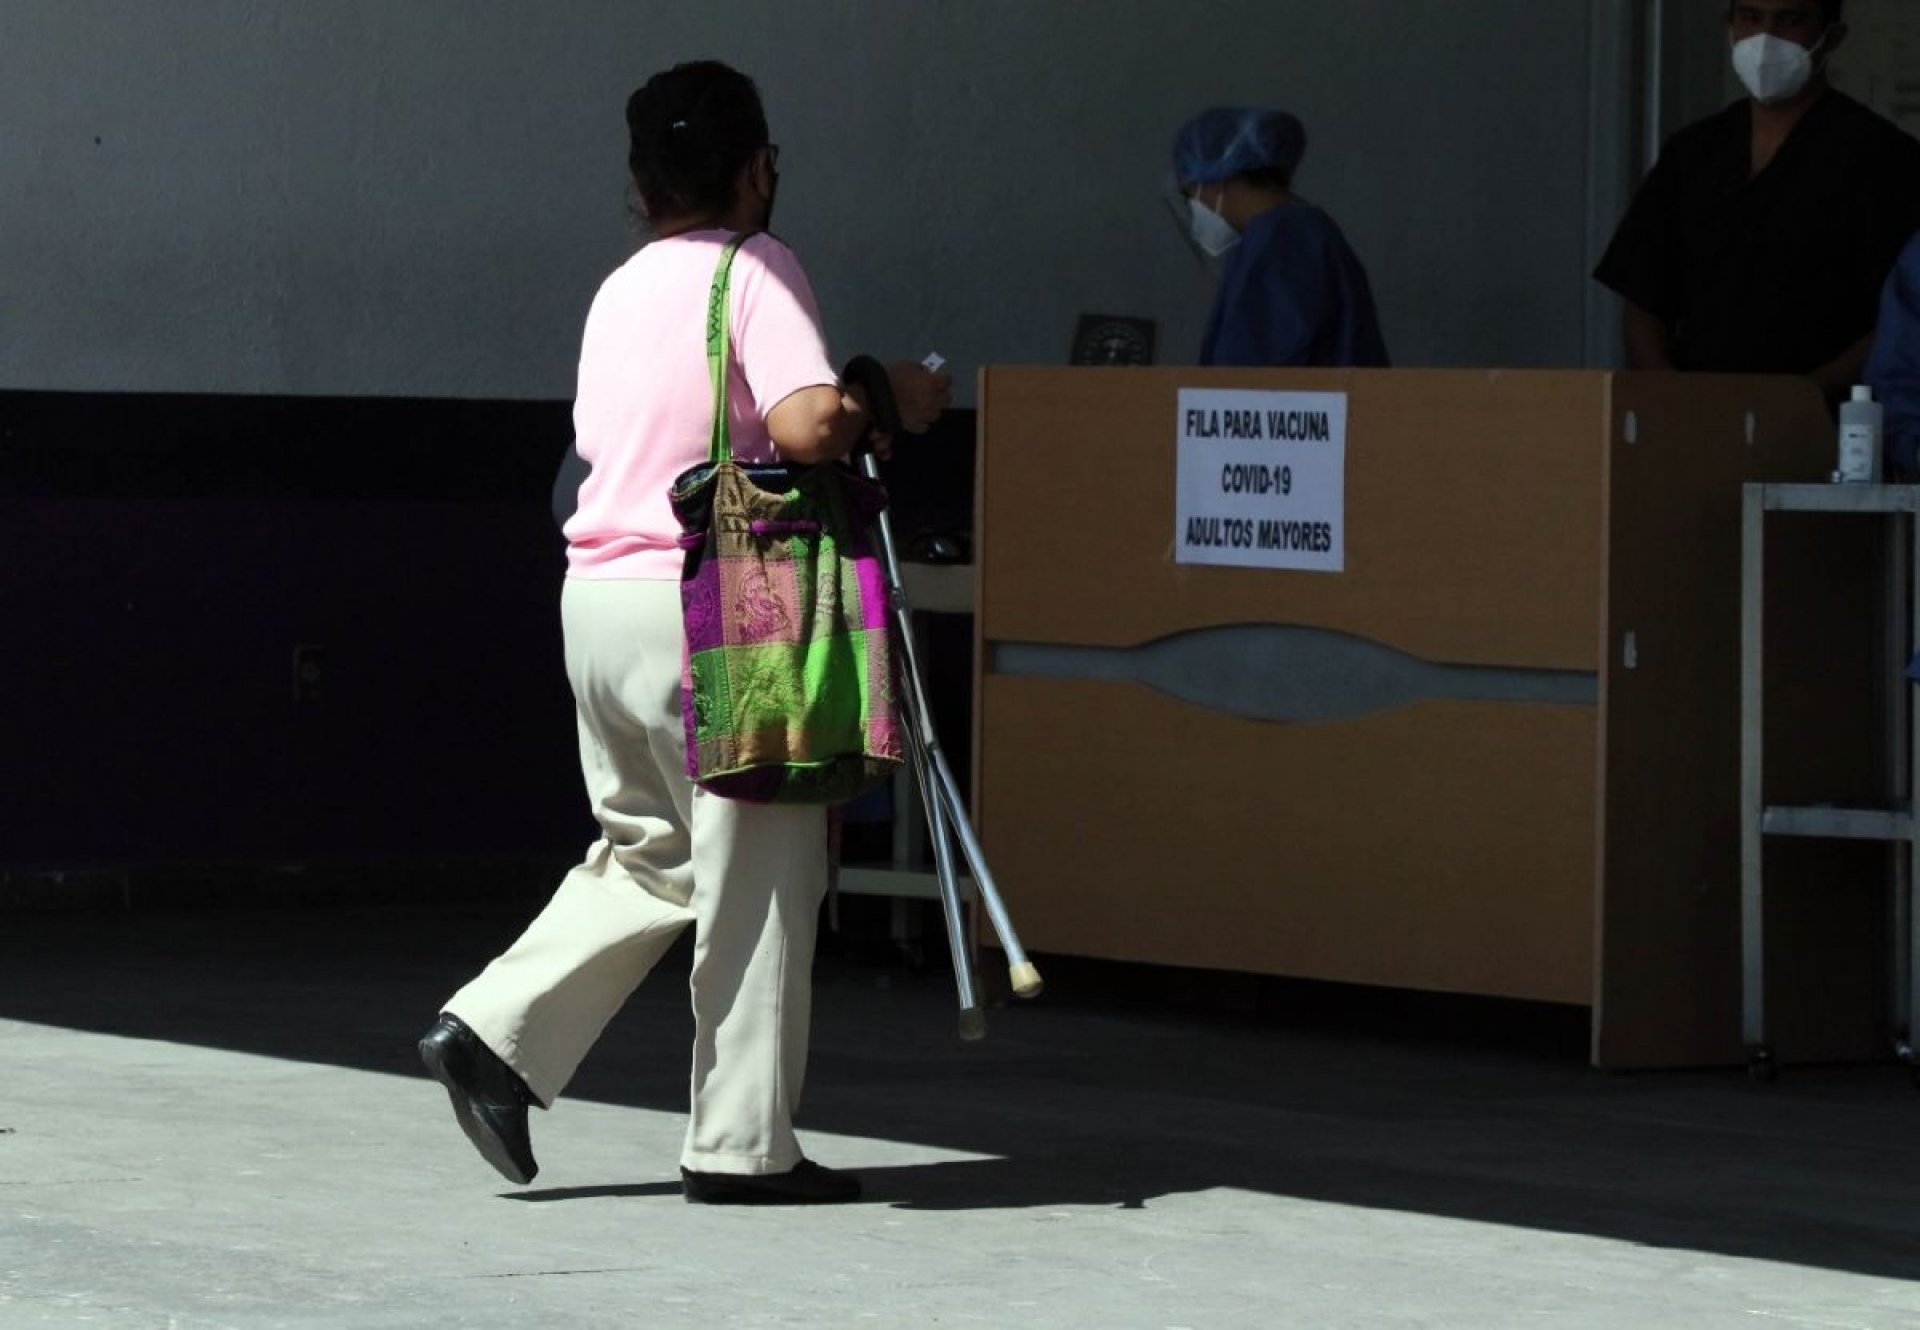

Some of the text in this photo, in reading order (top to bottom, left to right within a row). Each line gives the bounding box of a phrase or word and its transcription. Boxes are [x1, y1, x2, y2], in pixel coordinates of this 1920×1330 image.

[1186, 410, 1330, 441] FILA PARA VACUNA
[1222, 464, 1291, 494] COVID-19
[1186, 517, 1331, 552] ADULTOS MAYORES
